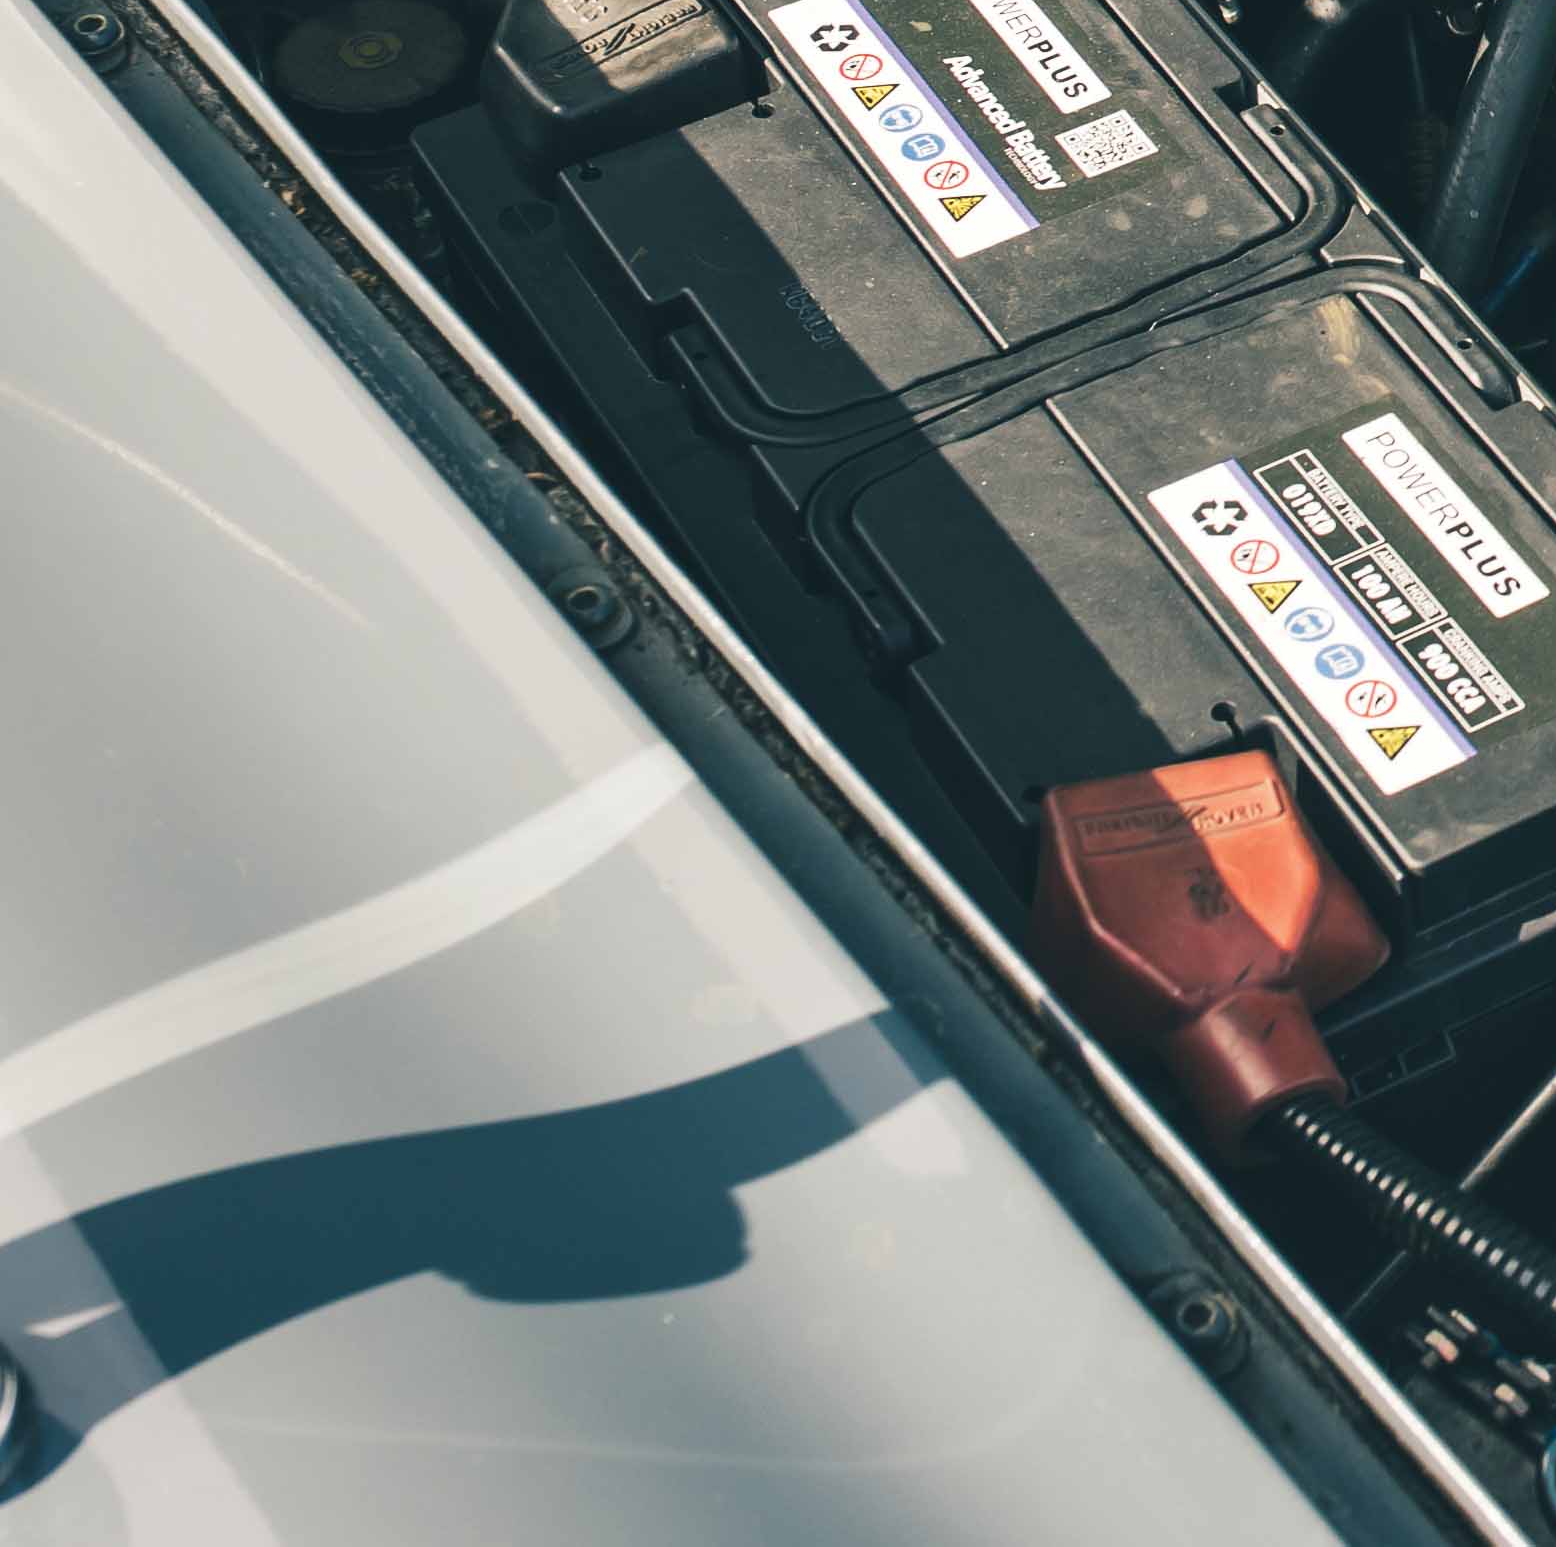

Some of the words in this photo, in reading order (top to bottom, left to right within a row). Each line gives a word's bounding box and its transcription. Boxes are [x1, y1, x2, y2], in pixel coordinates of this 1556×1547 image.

[942, 54, 1026, 136] Advanced
[1004, 128, 1066, 190] Battery
[1367, 431, 1520, 597] POWERPLUS
[1350, 564, 1393, 601] 100
[1417, 643, 1459, 682] 900
